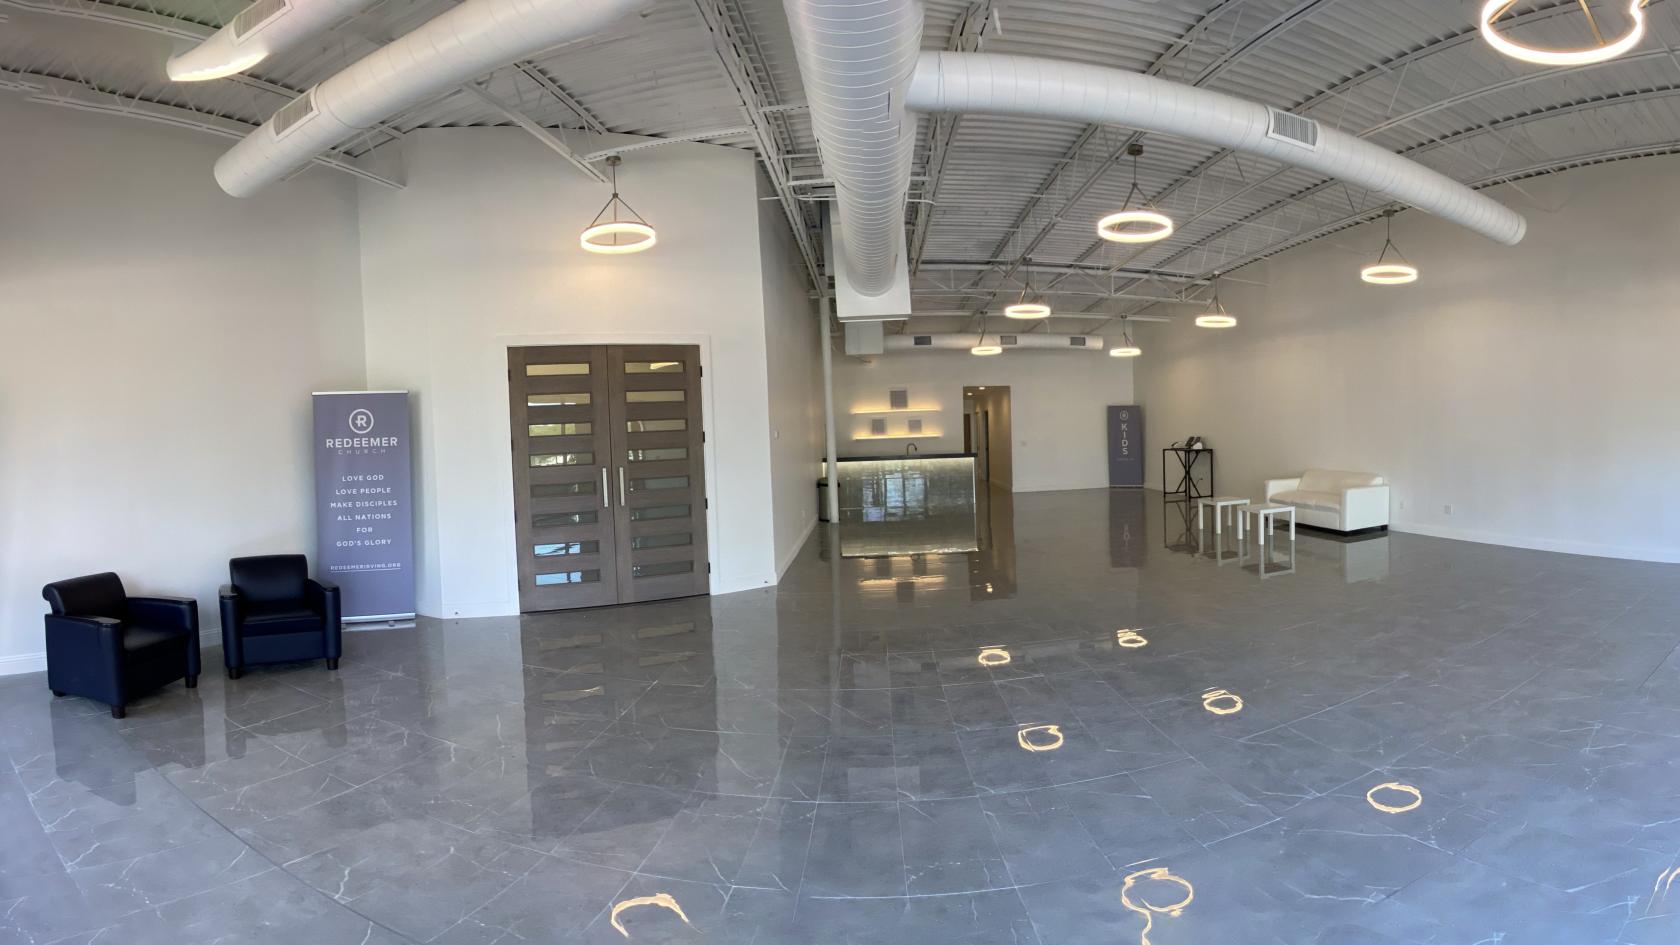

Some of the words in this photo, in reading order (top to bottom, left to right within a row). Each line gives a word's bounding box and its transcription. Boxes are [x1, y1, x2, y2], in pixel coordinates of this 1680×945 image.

[326, 437, 398, 448] REDEEMER
[1121, 423, 1129, 455] KIDS
[355, 500, 398, 508] DISCIPLES
[364, 538, 392, 546] GLORY
